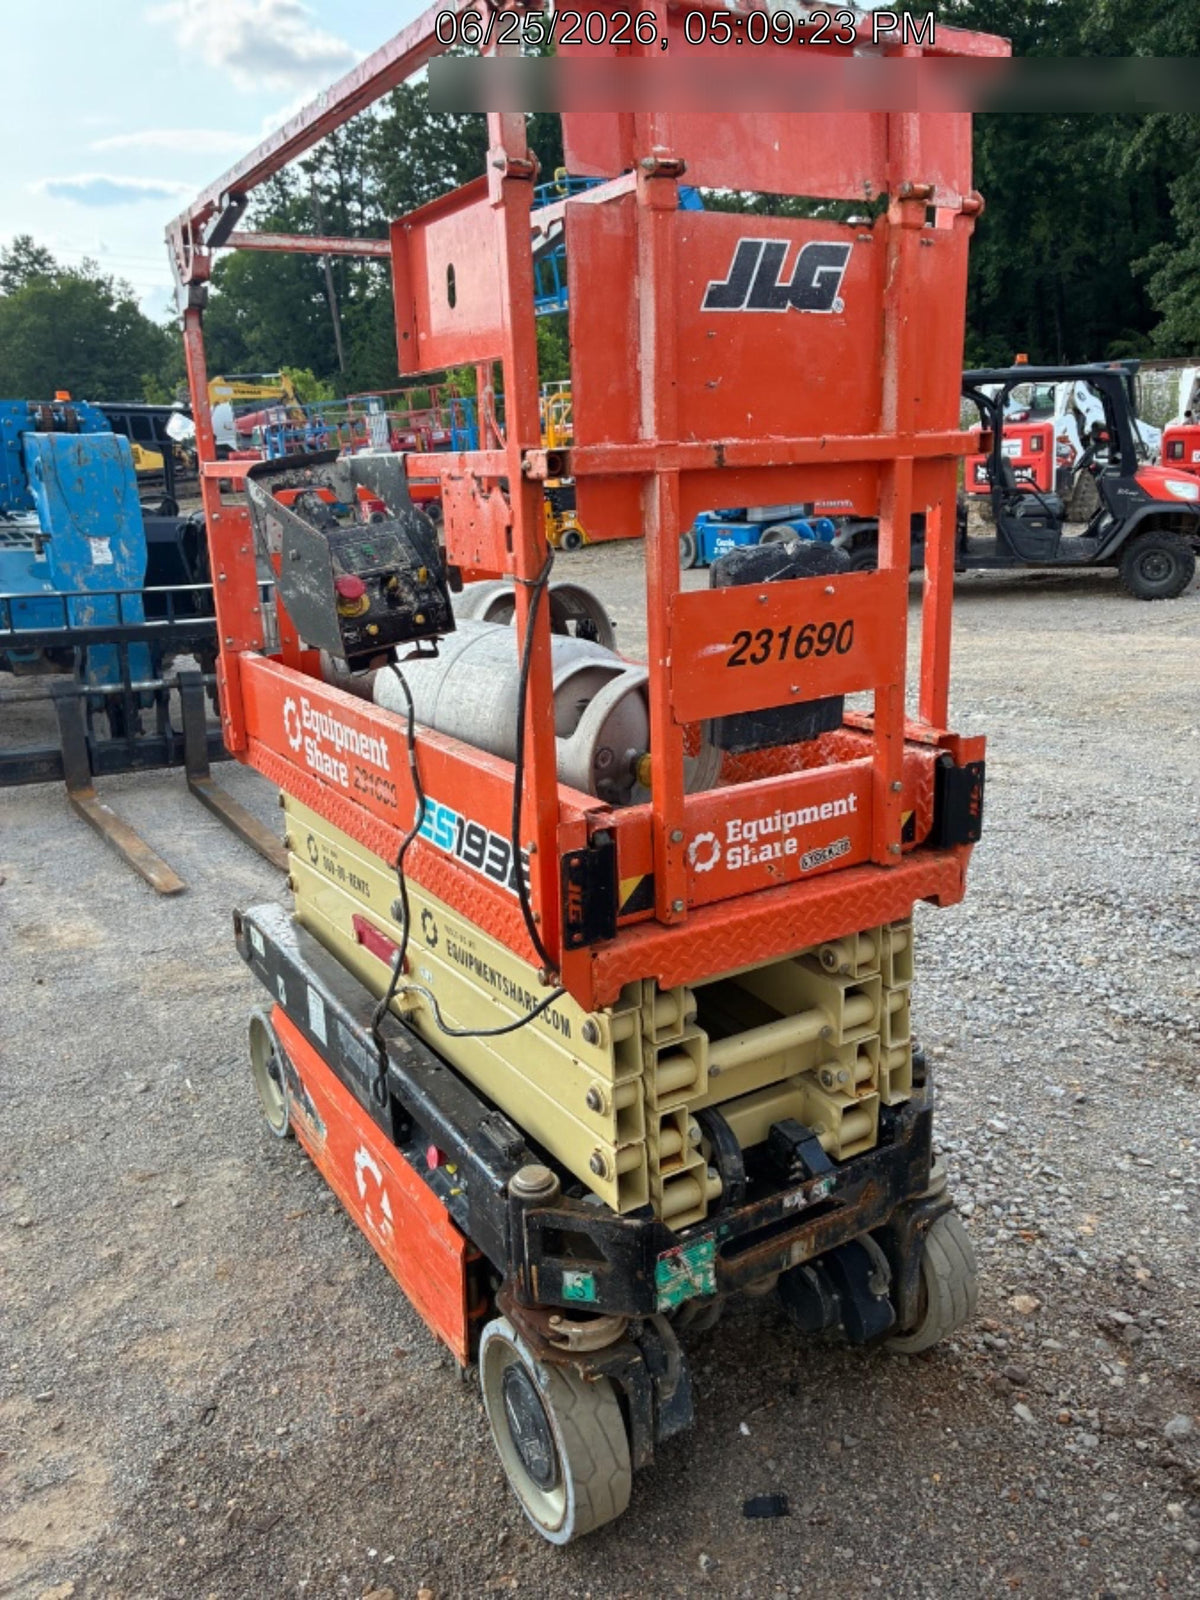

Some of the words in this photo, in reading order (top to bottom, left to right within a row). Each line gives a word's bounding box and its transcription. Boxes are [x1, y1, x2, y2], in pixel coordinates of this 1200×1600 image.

[700, 237, 853, 313] JLG
[727, 618, 855, 668] 231690
[300, 696, 391, 772] Equipment
[304, 735, 349, 788] Share
[726, 792, 858, 844] Equipment
[726, 837, 798, 870] Share
